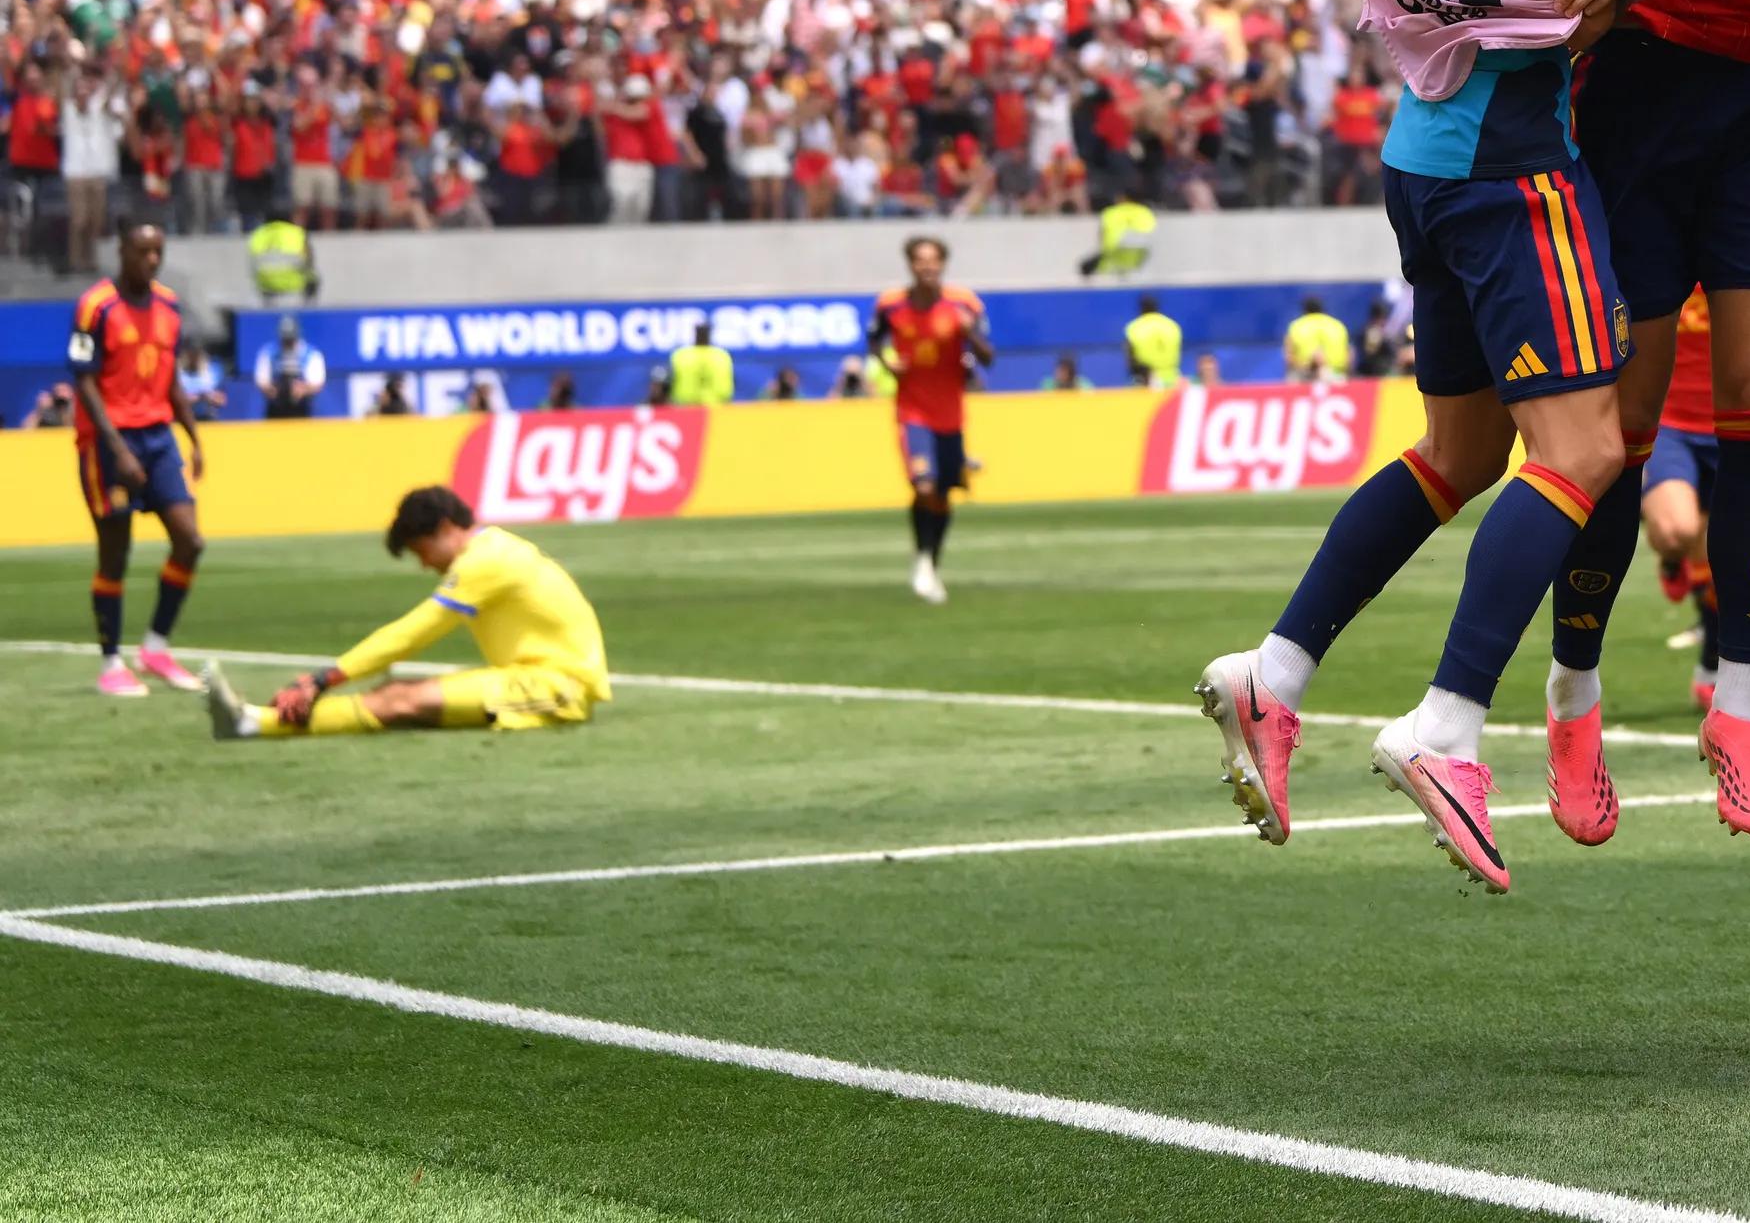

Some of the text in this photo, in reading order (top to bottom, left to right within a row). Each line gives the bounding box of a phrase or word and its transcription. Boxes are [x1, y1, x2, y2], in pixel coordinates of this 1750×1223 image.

[358, 316, 458, 360] FIFA
[458, 312, 619, 356] WORLD
[709, 303, 861, 350] 2026
[479, 404, 683, 521] Lay's
[1167, 381, 1357, 493] Lay's
